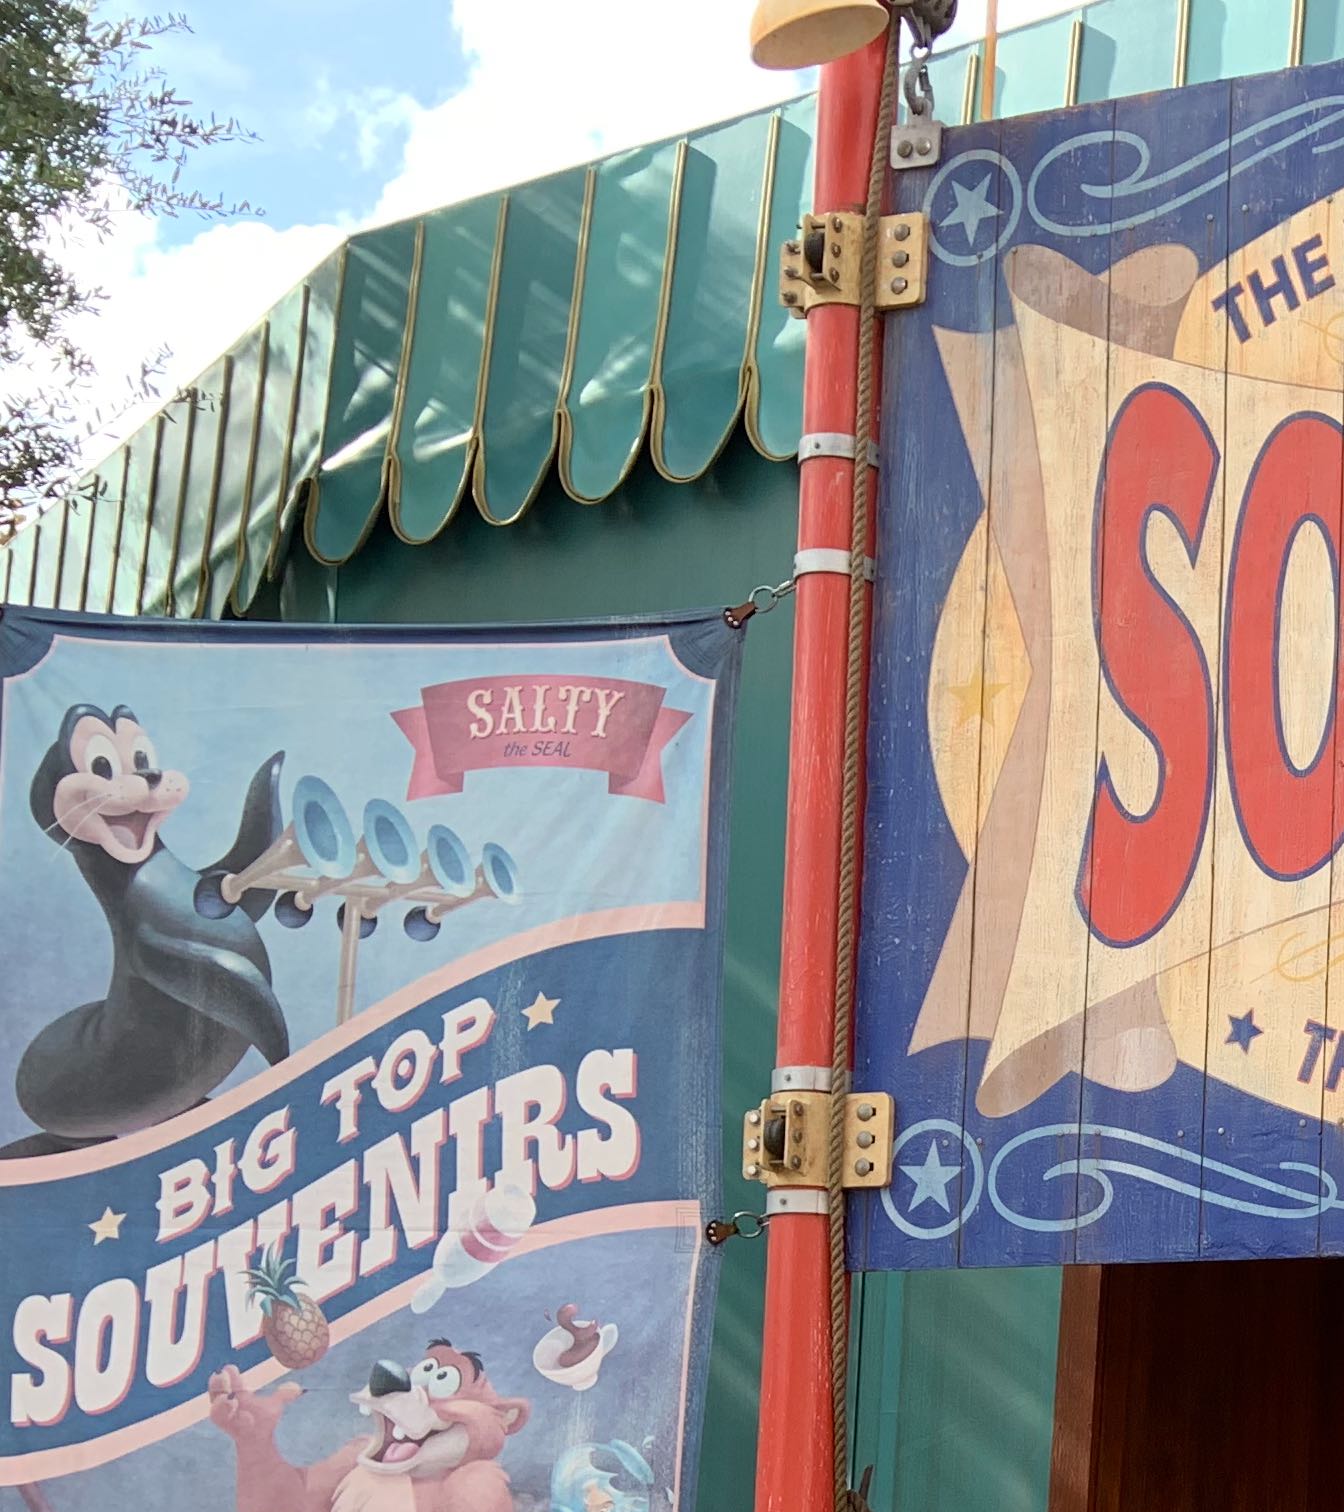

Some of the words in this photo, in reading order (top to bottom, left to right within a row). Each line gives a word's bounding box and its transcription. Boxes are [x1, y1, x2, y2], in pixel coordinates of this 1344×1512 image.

[1210, 235, 1336, 345] THE
[466, 684, 625, 739] SALTY
[503, 741, 528, 758] the
[531, 740, 571, 758] SEAL
[155, 1106, 297, 1243] BIG
[320, 996, 497, 1143] TOP
[10, 1047, 642, 1427] SOUVENIRS
